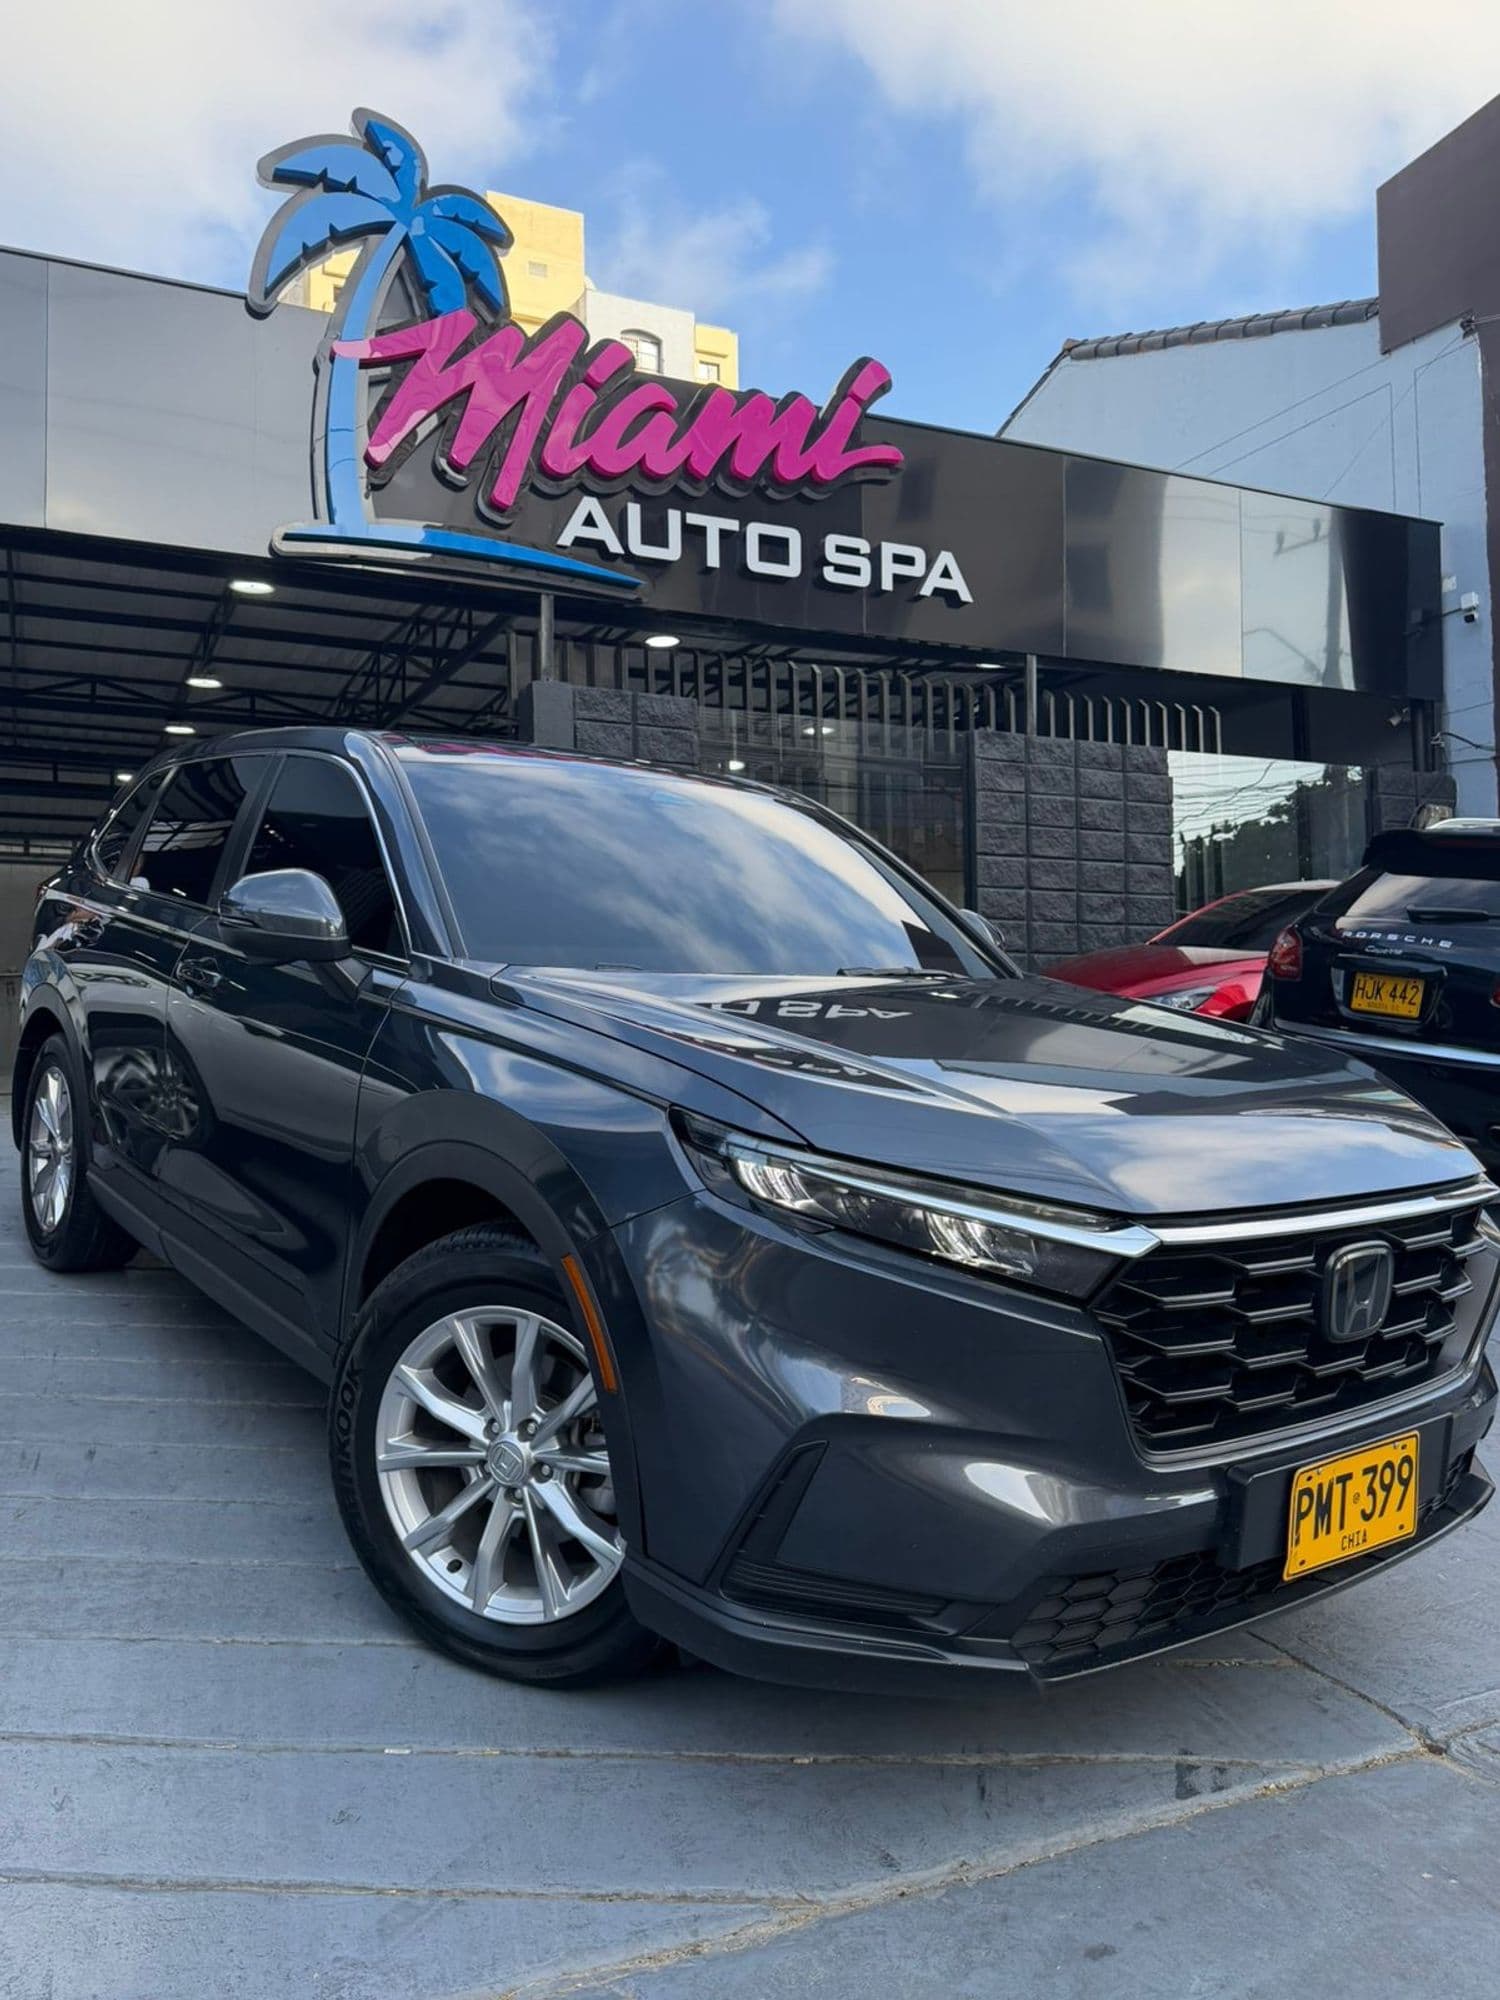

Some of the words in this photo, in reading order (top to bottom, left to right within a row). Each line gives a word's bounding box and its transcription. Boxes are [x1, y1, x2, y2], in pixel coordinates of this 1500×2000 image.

[332, 310, 906, 511] Miami
[557, 496, 804, 579] AUTO
[823, 534, 975, 604] SPA
[1341, 930, 1453, 949] PORSCHE
[1355, 977, 1386, 1003] HJK
[1388, 982, 1420, 1006] 442
[1295, 1472, 1354, 1547] PMT
[1360, 1455, 1414, 1522] 399
[1341, 1528, 1368, 1551] CHIA
